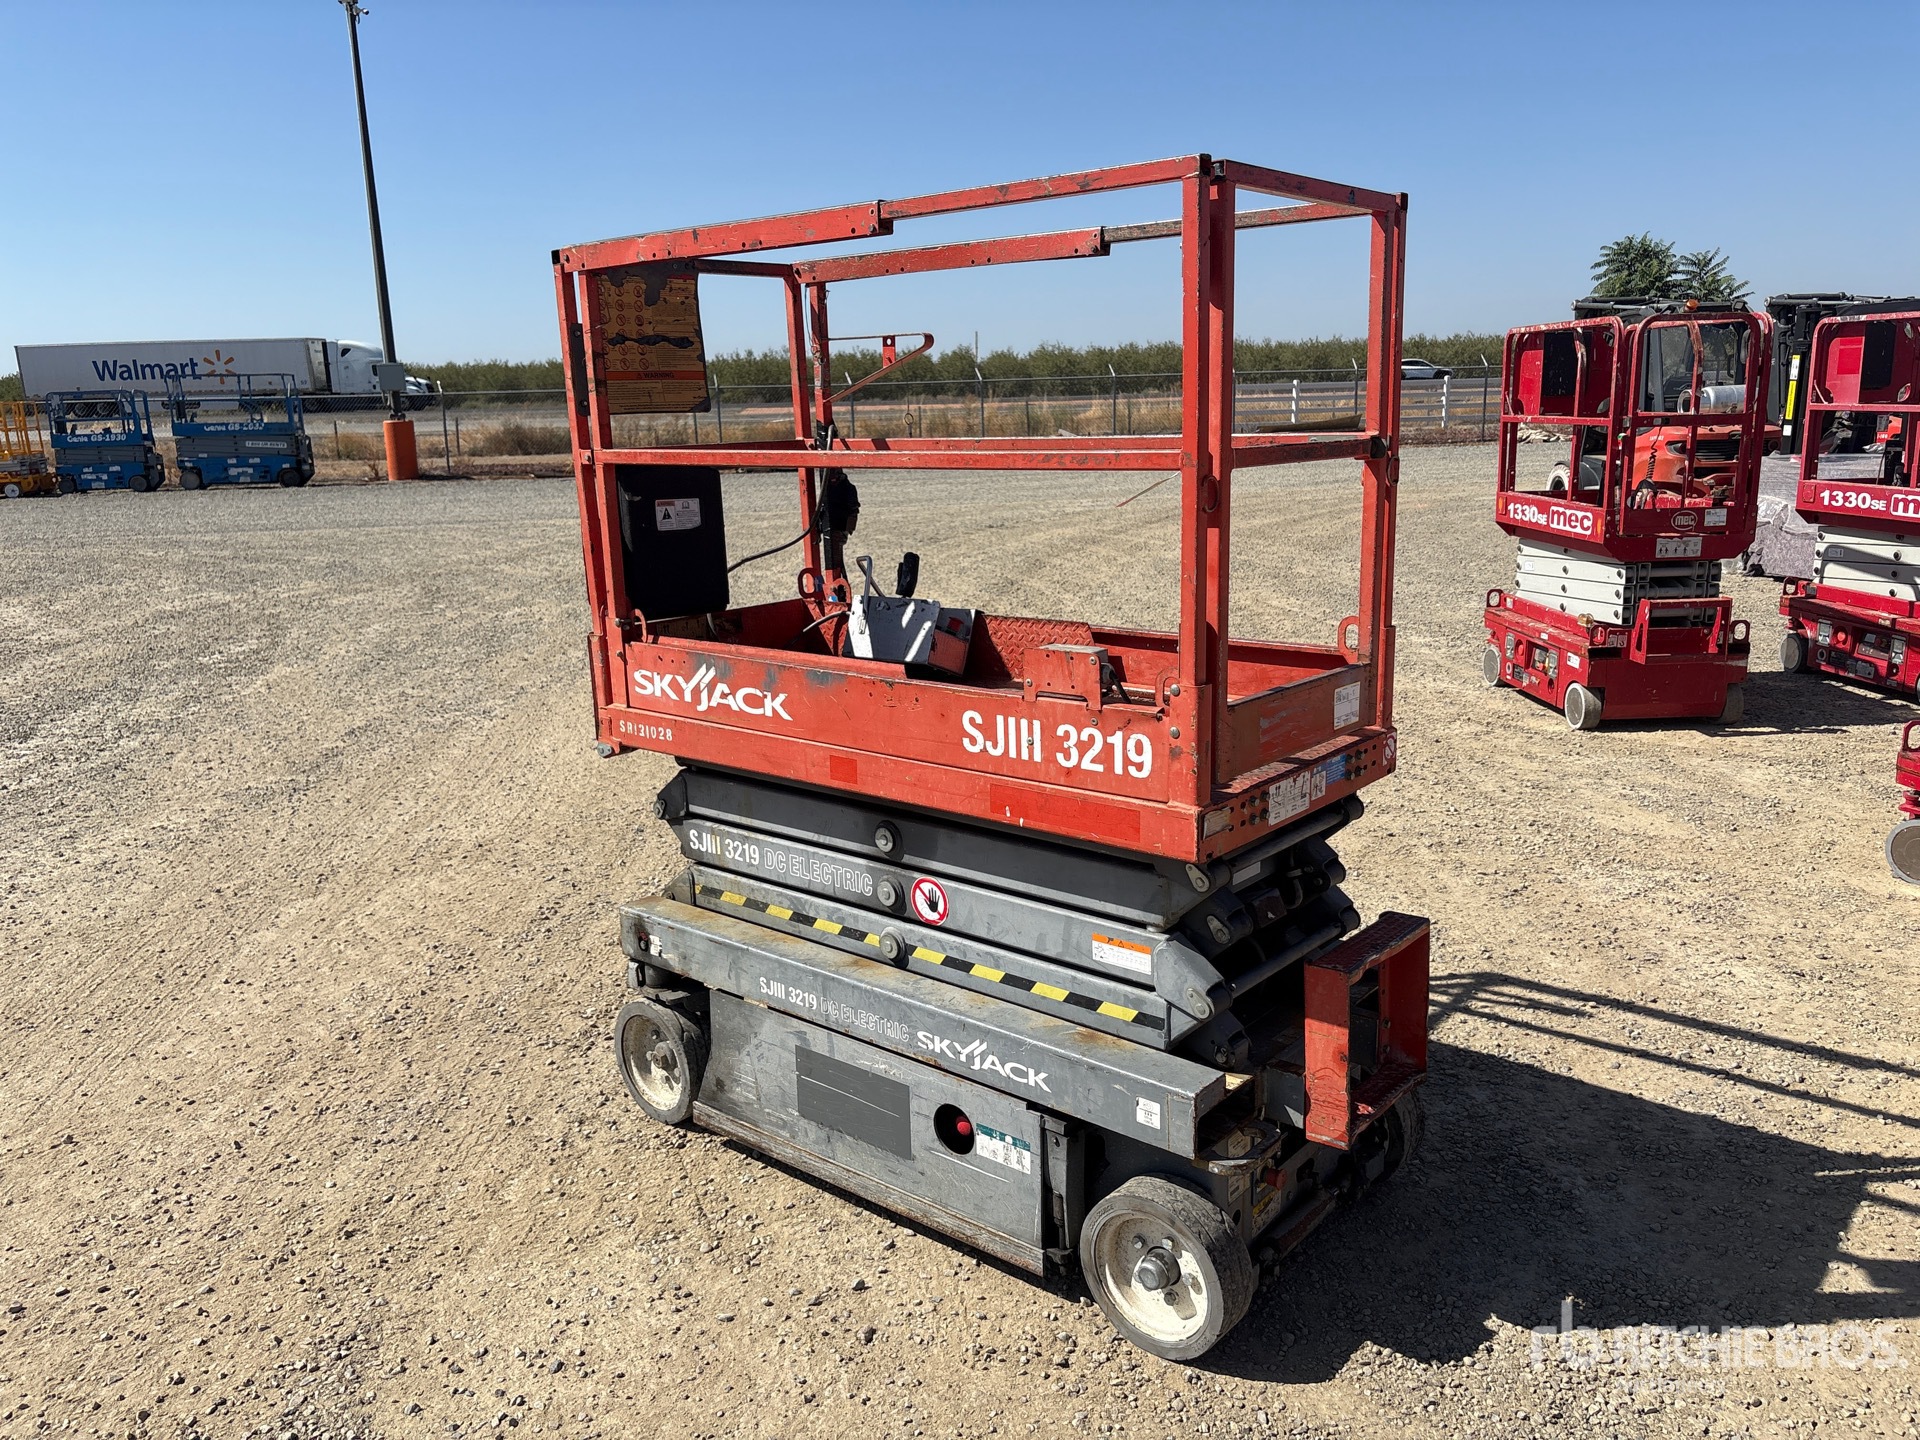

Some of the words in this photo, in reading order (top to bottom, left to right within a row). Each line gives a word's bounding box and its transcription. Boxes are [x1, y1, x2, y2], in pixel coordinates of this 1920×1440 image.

[92, 358, 202, 381] Walmart
[633, 663, 794, 722] SKYJACK
[1055, 723, 1153, 779] 3219
[725, 838, 760, 865] 3219
[763, 847, 787, 873] DC
[789, 854, 873, 897] ELECTRIC
[788, 986, 817, 1010] 3219
[820, 996, 839, 1018] DC
[841, 1003, 910, 1042] ELECTRIC
[916, 1030, 1052, 1093] SKYJACK
